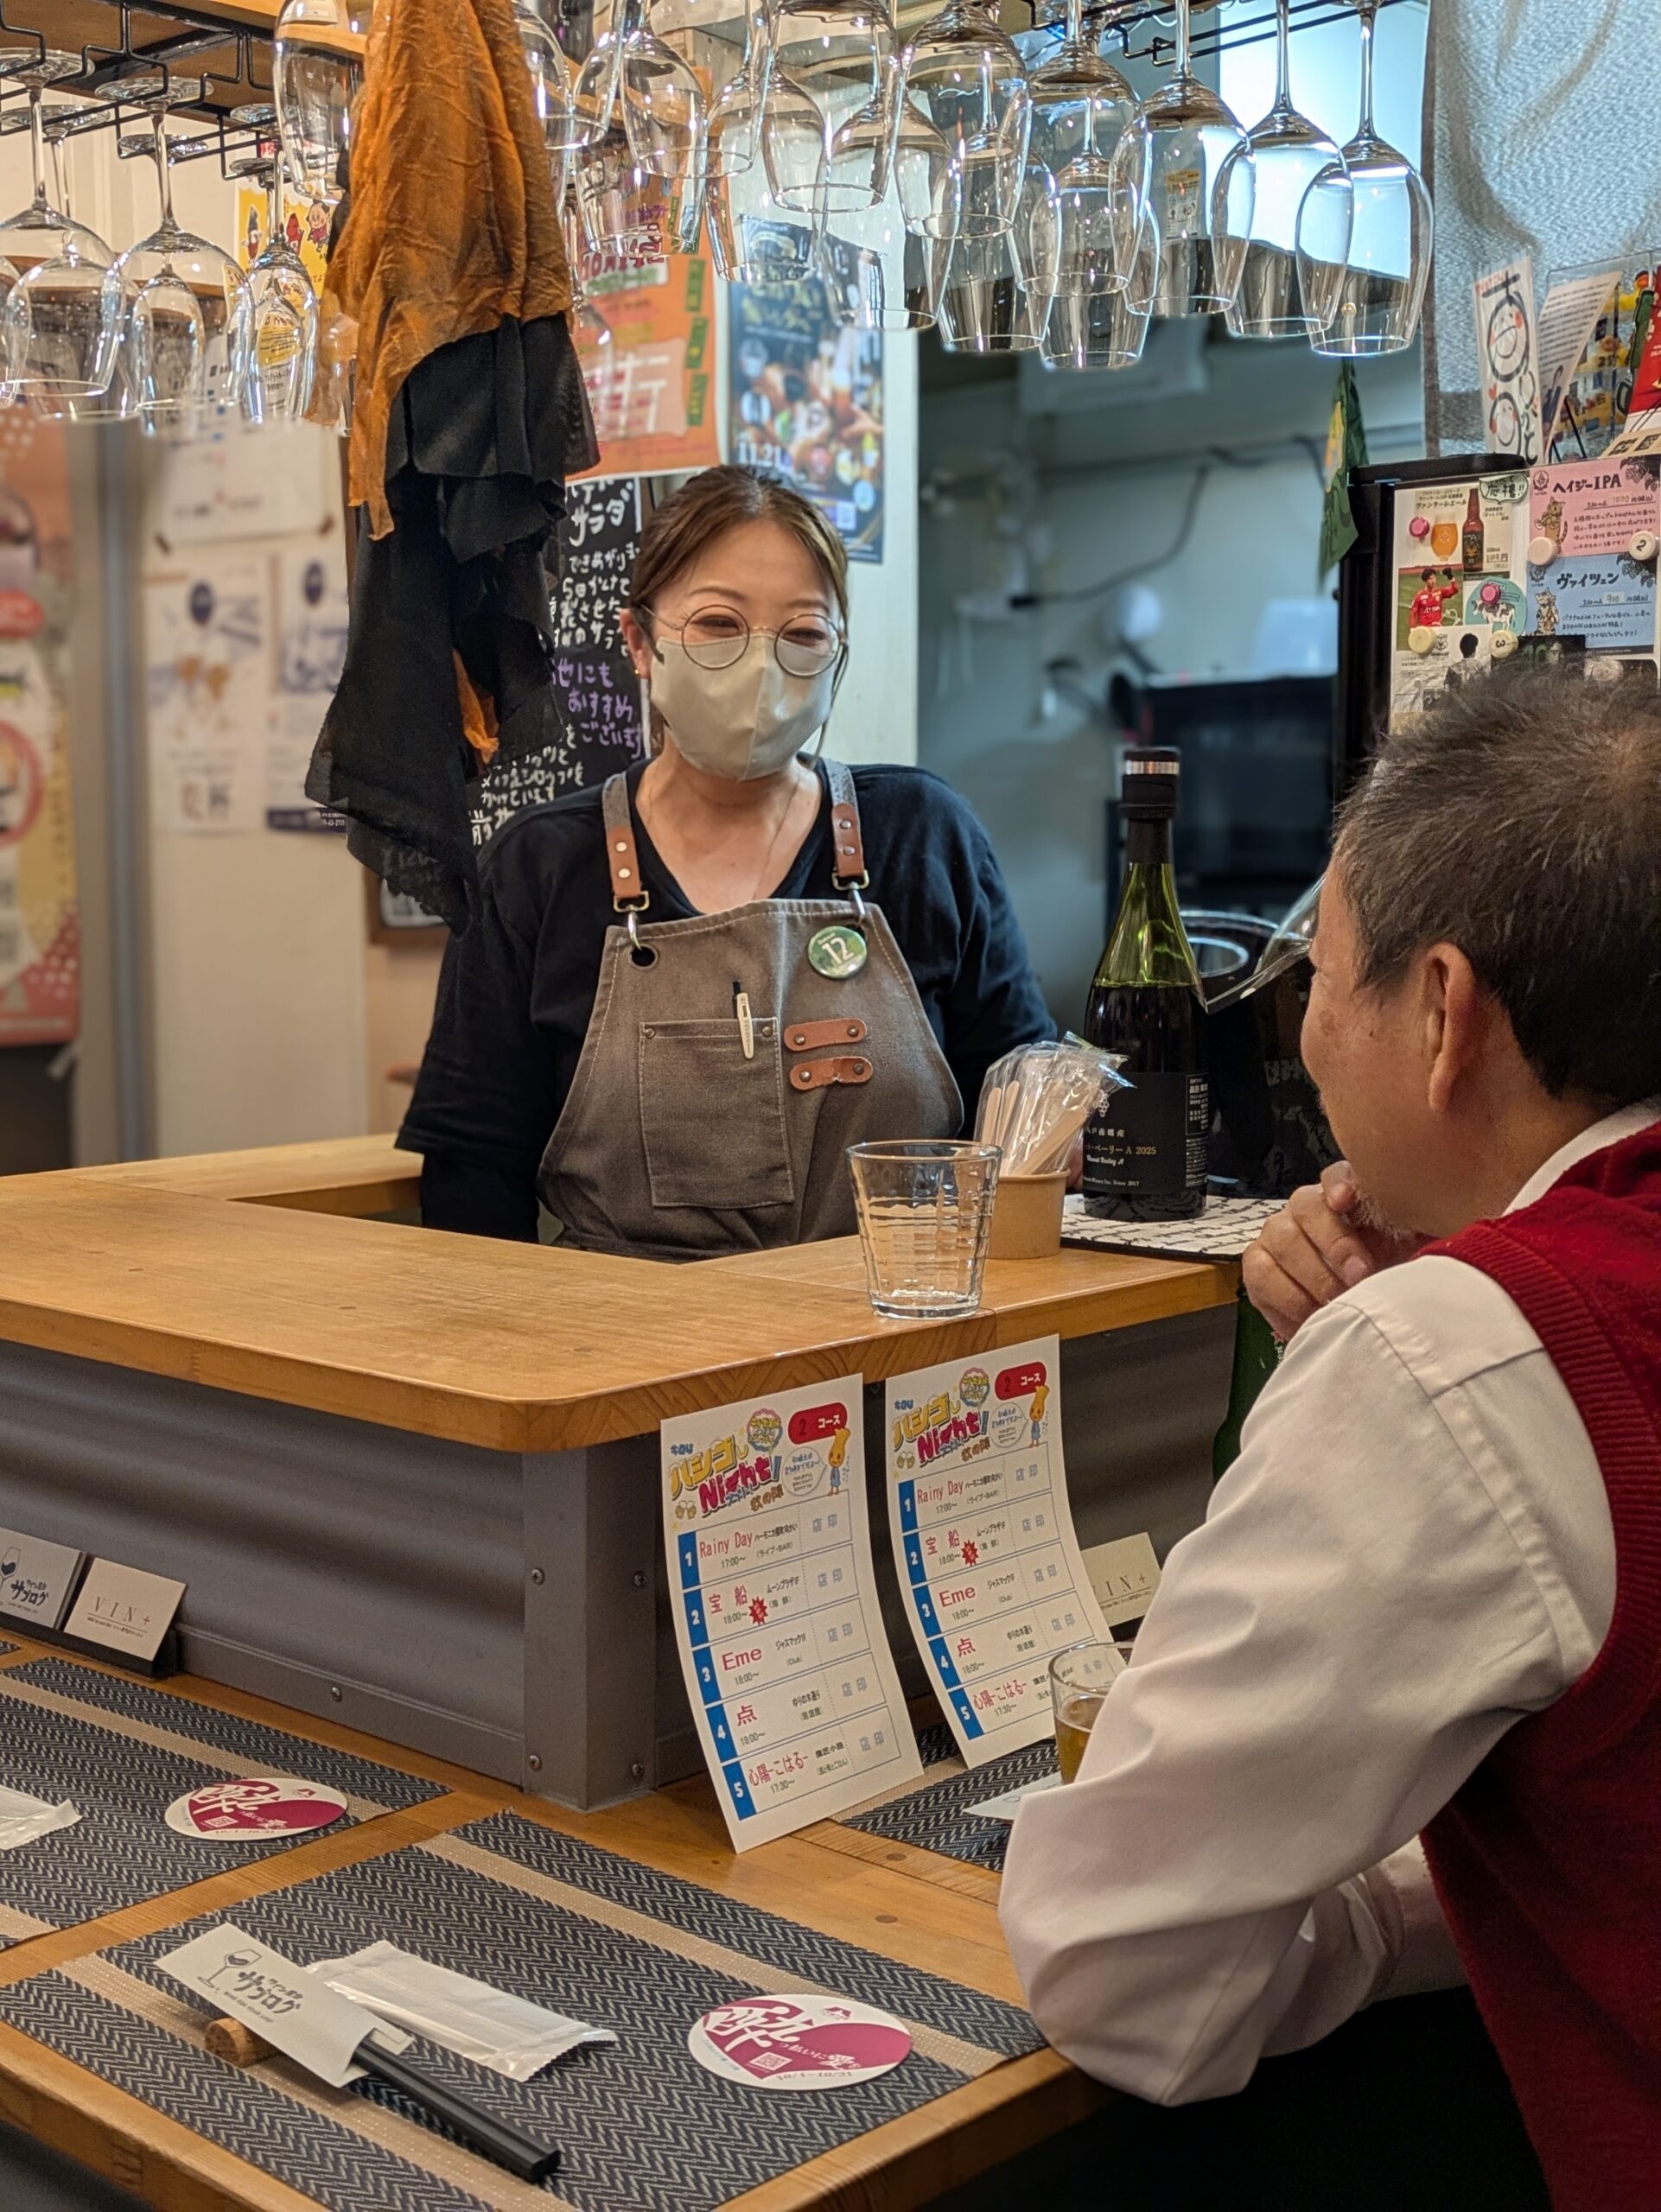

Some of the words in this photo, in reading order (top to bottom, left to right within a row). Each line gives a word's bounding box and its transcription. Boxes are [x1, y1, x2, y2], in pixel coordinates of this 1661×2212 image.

[1553, 474, 1622, 493] ヘイジーIPA
[569, 481, 633, 547] サラダ
[1636, 539, 1647, 551] 2
[1556, 573, 1620, 589] ヴァイツェン
[568, 688, 633, 721] おすすめ
[580, 721, 643, 759] ございます
[821, 937, 855, 965] 12
[1136, 1146, 1157, 1155] 2025
[1020, 1372, 1041, 1387] コース
[818, 1414, 841, 1429] コース
[749, 1484, 785, 1512] 秋の陣
[904, 1498, 912, 1512] 1
[917, 1487, 944, 1505] Rainy
[947, 1480, 964, 1497] Day
[684, 1552, 693, 1567] 1
[699, 1538, 730, 1560] Rainy
[735, 1531, 754, 1549] Day
[911, 1552, 919, 1566] 2
[10, 1580, 49, 1606] サブログ
[922, 1604, 931, 1618] 3
[939, 1586, 977, 1608] Eme
[690, 1611, 701, 1625] 2
[702, 1667, 711, 1682] 3
[721, 1647, 762, 1672] Eme
[939, 1655, 949, 1669] 4
[957, 1637, 977, 1658] 点
[716, 1725, 727, 1740] 4
[736, 1704, 758, 1727] 点
[960, 1706, 971, 1720] 5
[734, 1783, 744, 1799] 5
[233, 1970, 302, 2014] サブログ
